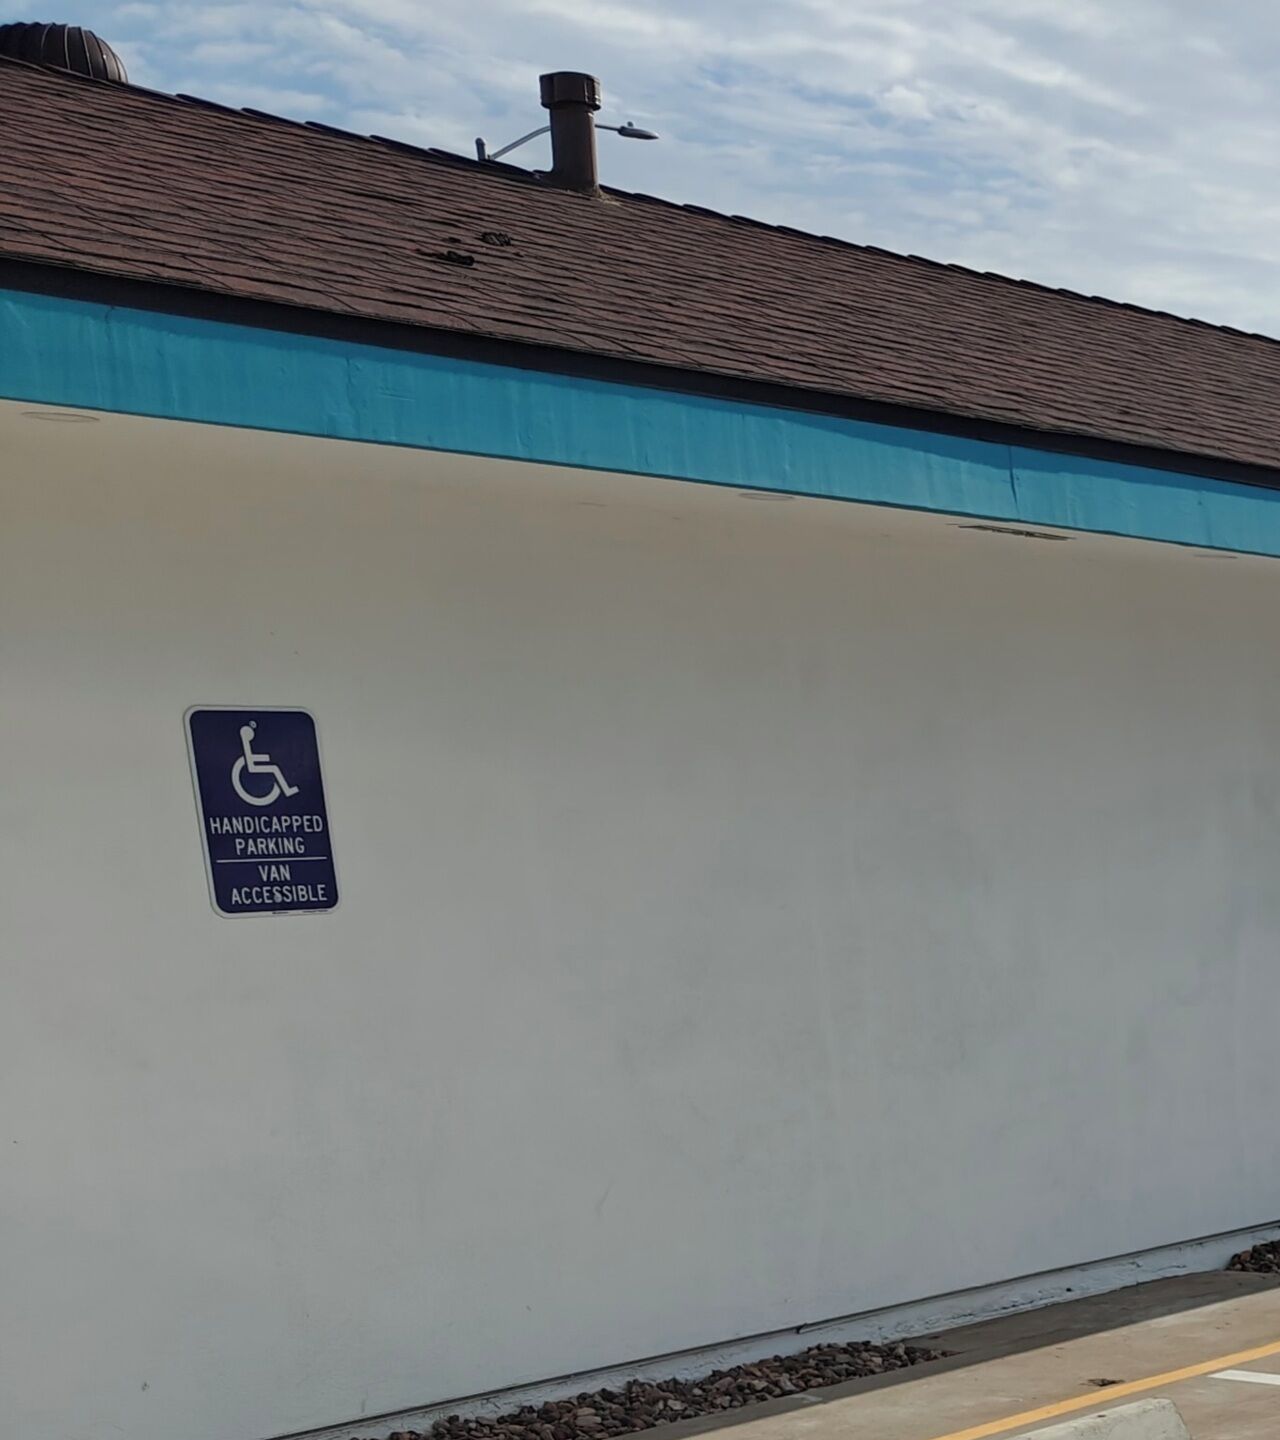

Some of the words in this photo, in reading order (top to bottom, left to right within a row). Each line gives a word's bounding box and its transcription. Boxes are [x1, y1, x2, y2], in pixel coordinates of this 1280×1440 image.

[210, 815, 323, 835] HANDICAPPED
[235, 837, 305, 856] PARKING
[258, 864, 291, 881] VAN
[231, 884, 327, 905] ACCESSIBLE
